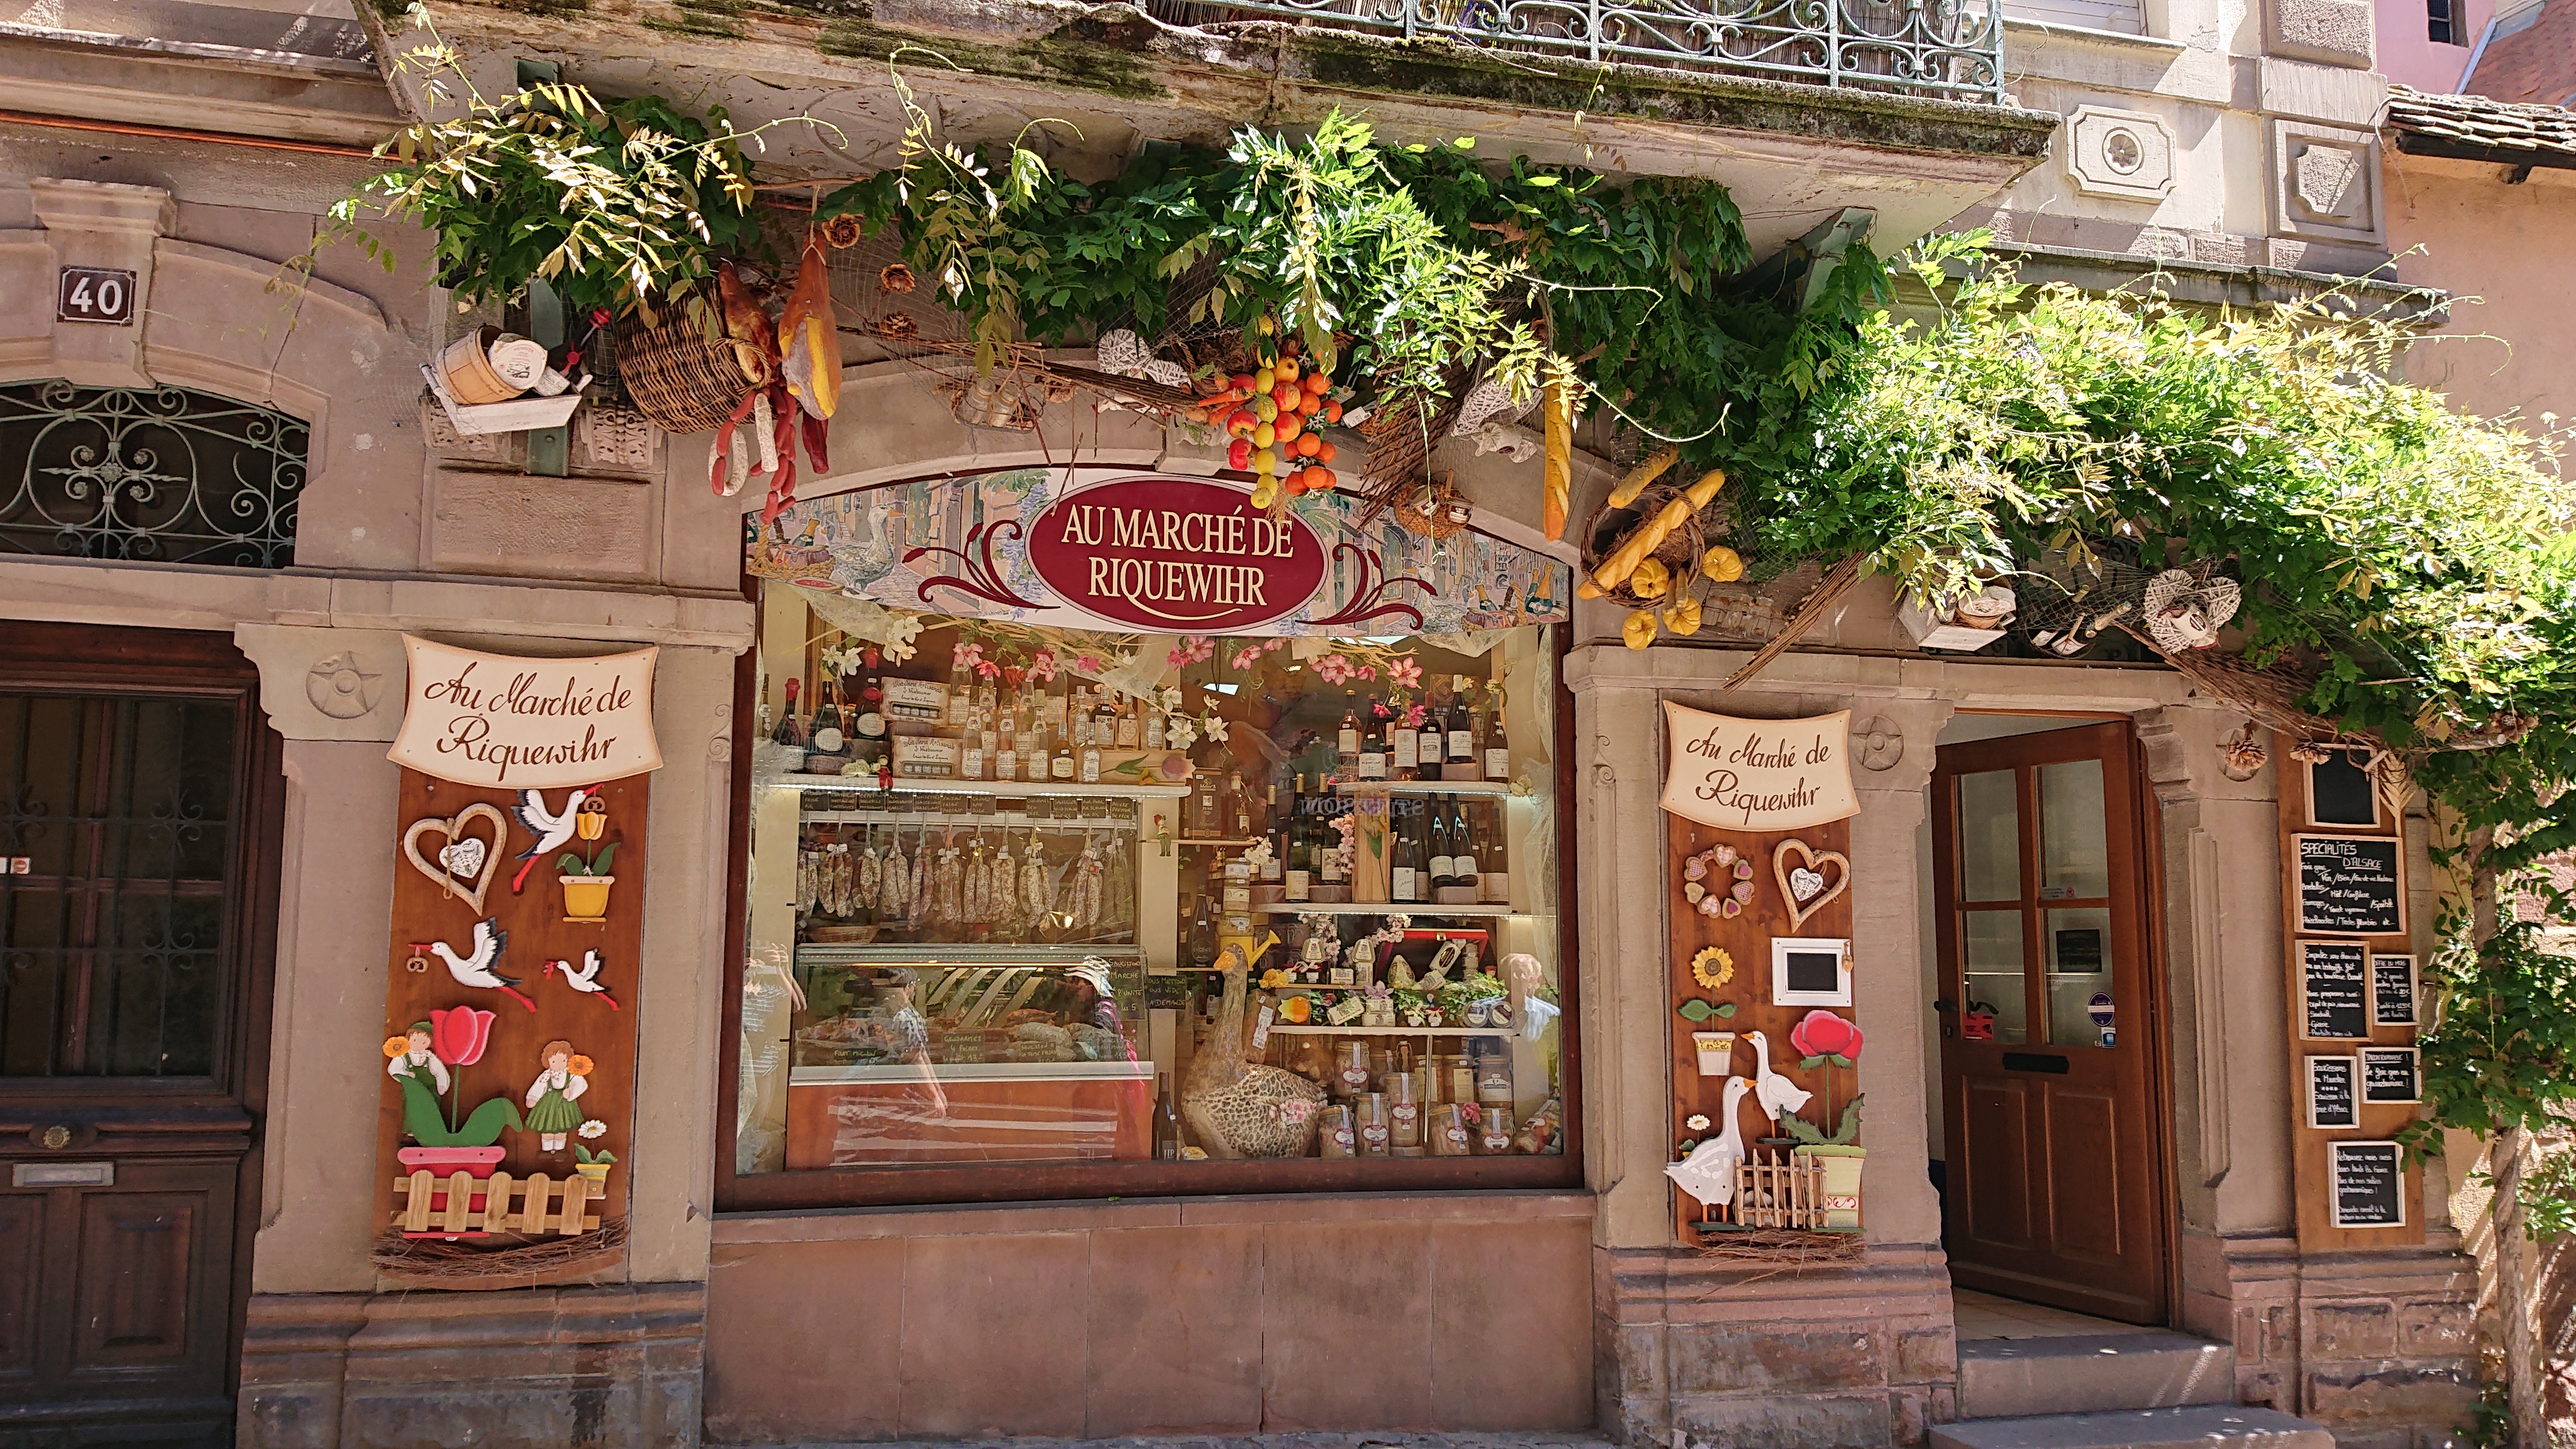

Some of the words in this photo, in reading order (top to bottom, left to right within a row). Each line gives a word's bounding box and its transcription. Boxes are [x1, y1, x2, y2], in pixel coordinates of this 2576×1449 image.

[69, 277, 122, 315] 40
[1061, 504, 1106, 546] AU
[1112, 504, 1247, 555] MARCHÉ
[1251, 517, 1294, 558] DE
[1088, 557, 1268, 620] RIQUEWIHR
[424, 661, 483, 710] Au
[488, 672, 594, 716] Marché
[597, 675, 633, 713] de
[436, 715, 617, 782] Riquewihr
[1686, 726, 1722, 760] Au
[1729, 732, 1797, 768] Marché
[1805, 734, 1831, 765] de
[1695, 770, 1820, 825] Riquewihr
[2342, 857, 2383, 868] D'ALSACE
